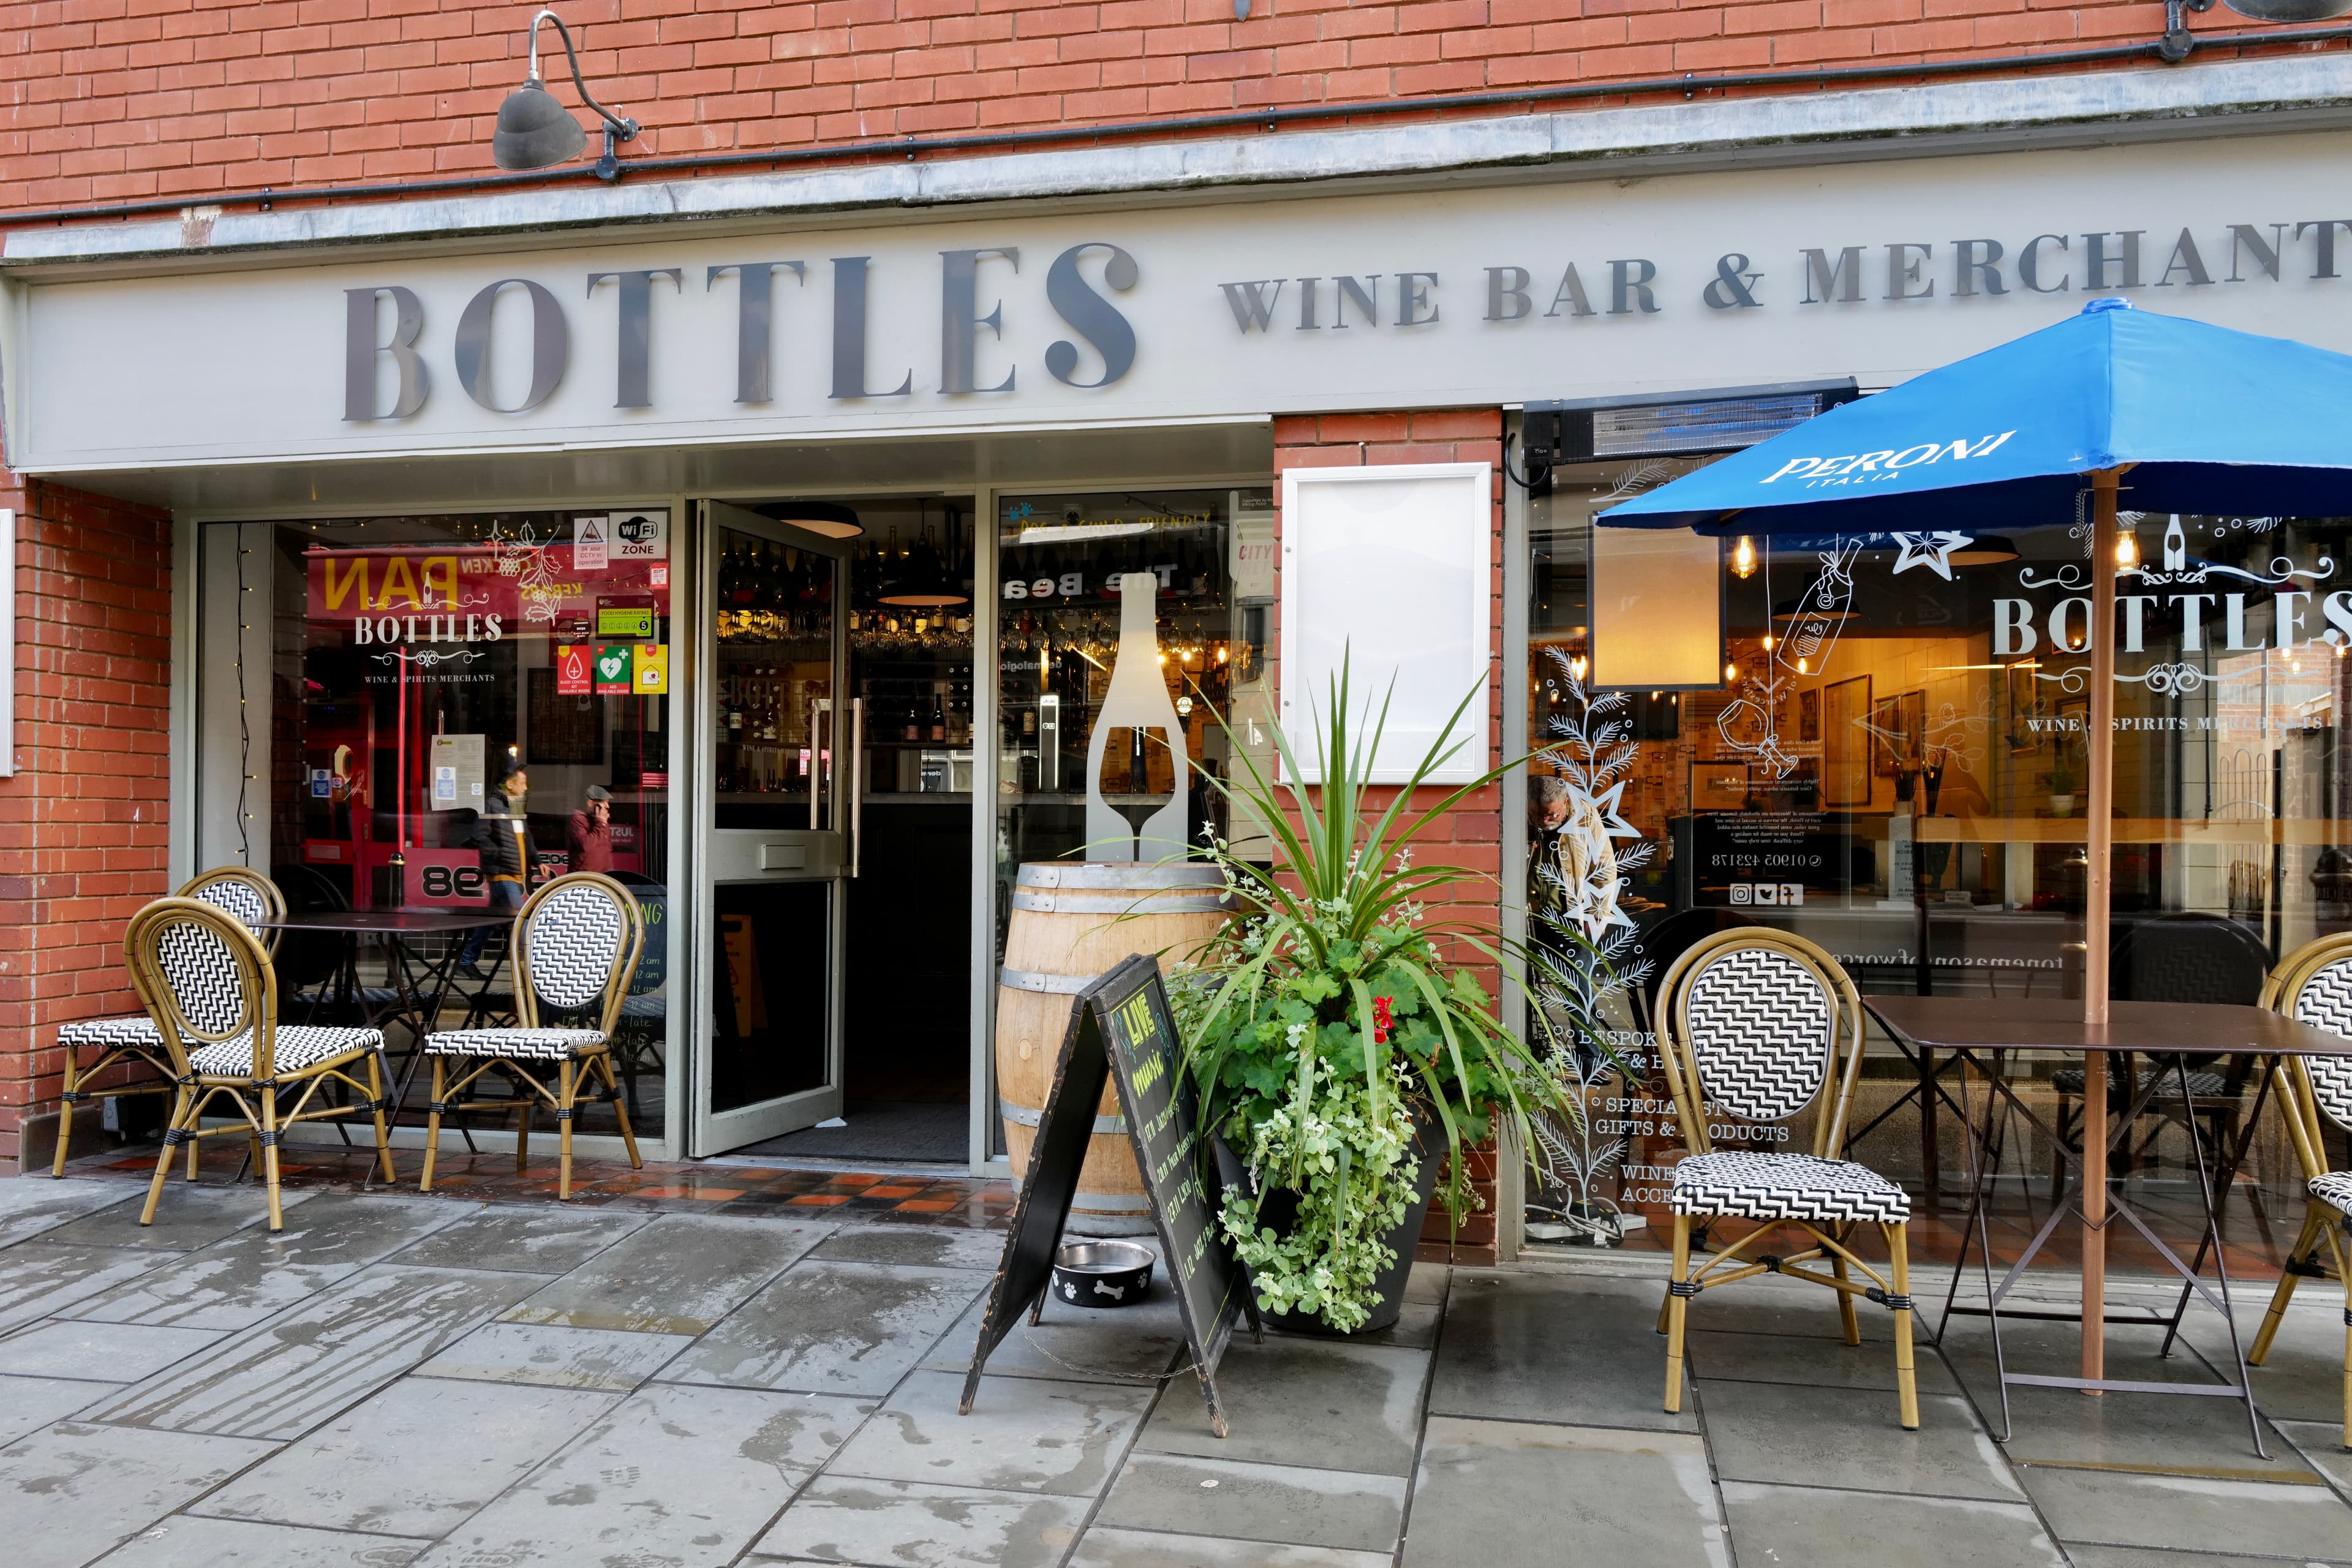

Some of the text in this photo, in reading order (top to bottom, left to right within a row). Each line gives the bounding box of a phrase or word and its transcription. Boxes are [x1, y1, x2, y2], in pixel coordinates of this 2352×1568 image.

[1218, 273, 1439, 335] WINE
[1482, 258, 1662, 321] BAR
[1703, 253, 1764, 309] &
[341, 243, 1137, 421] BOTTLES
[1759, 430, 2017, 484] PERONI
[1806, 471, 1899, 489] ITALIA
[1020, 521, 1047, 533] DOG
[1079, 519, 1124, 532] CHILD
[1139, 513, 1210, 529] FRIENDLY
[622, 546, 654, 554] ZONE
[1238, 545, 1272, 560] CITY
[355, 613, 502, 644] BOTTLES
[1992, 590, 2352, 655] BOTTLES
[2027, 719, 2080, 733] WINE
[2113, 717, 2188, 731] SPIRITS
[635, 970, 643, 979] 12
[1122, 992, 1156, 1050] LIVE
[1579, 1029, 1673, 1047] BESPOK
[1133, 1049, 1164, 1099] music
[1595, 1119, 1789, 1142] GIFTS & ODUCTS
[1157, 1161, 1169, 1184] 20.11
[1620, 1165, 1675, 1182] WINE
[1167, 1194, 1181, 1224] 27.11
[1184, 1255, 1195, 1281] 1.12
